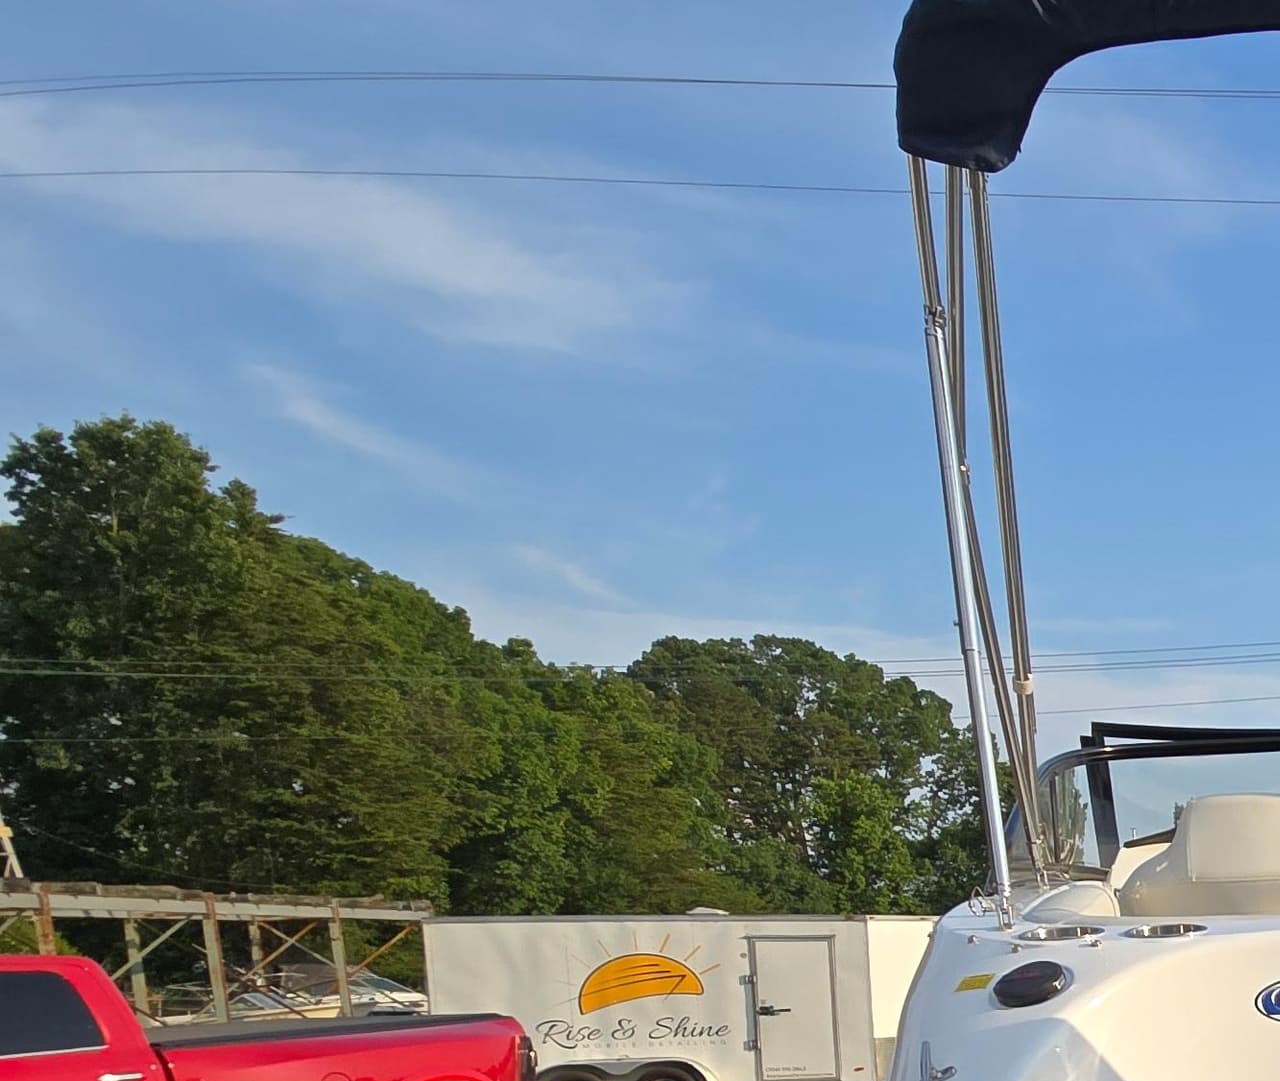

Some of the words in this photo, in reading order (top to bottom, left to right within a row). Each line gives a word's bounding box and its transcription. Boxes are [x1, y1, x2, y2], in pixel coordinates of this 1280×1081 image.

[535, 1018, 604, 1050] Rise
[610, 1018, 637, 1041] &
[648, 1016, 732, 1040] Shine
